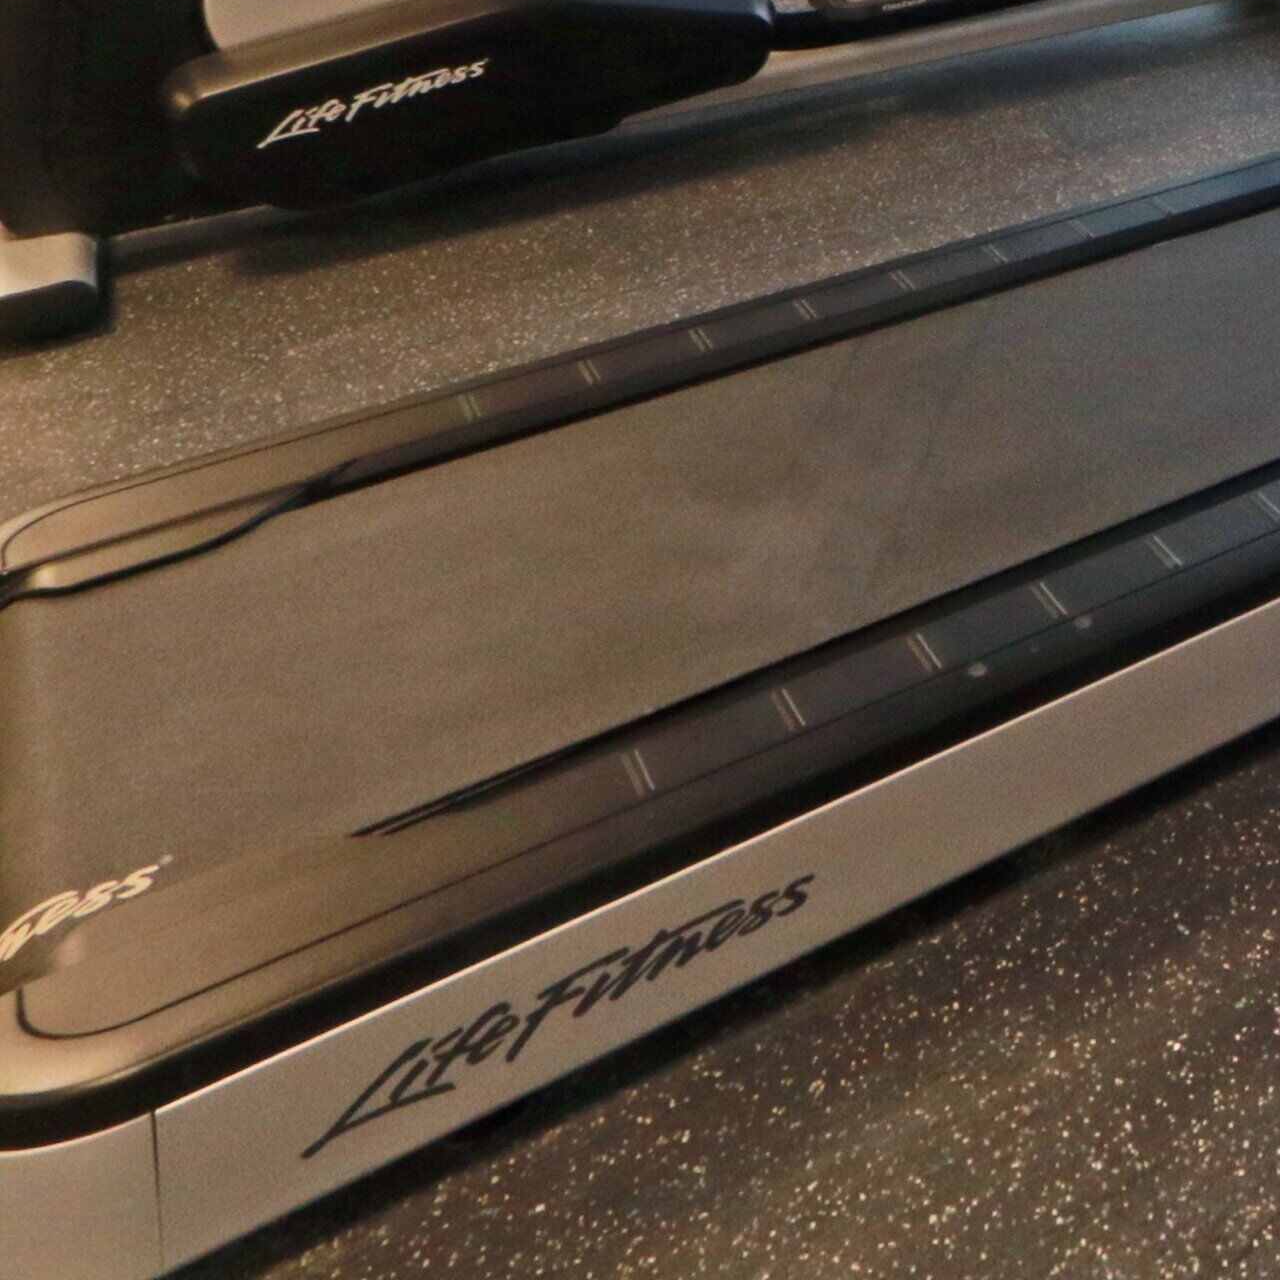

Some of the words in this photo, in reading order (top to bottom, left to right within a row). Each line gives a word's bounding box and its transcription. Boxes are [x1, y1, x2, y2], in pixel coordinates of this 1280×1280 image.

[256, 98, 347, 149] Life
[345, 60, 487, 122] Fitness
[302, 1001, 522, 1160] Life
[506, 874, 815, 1063] Fitness
